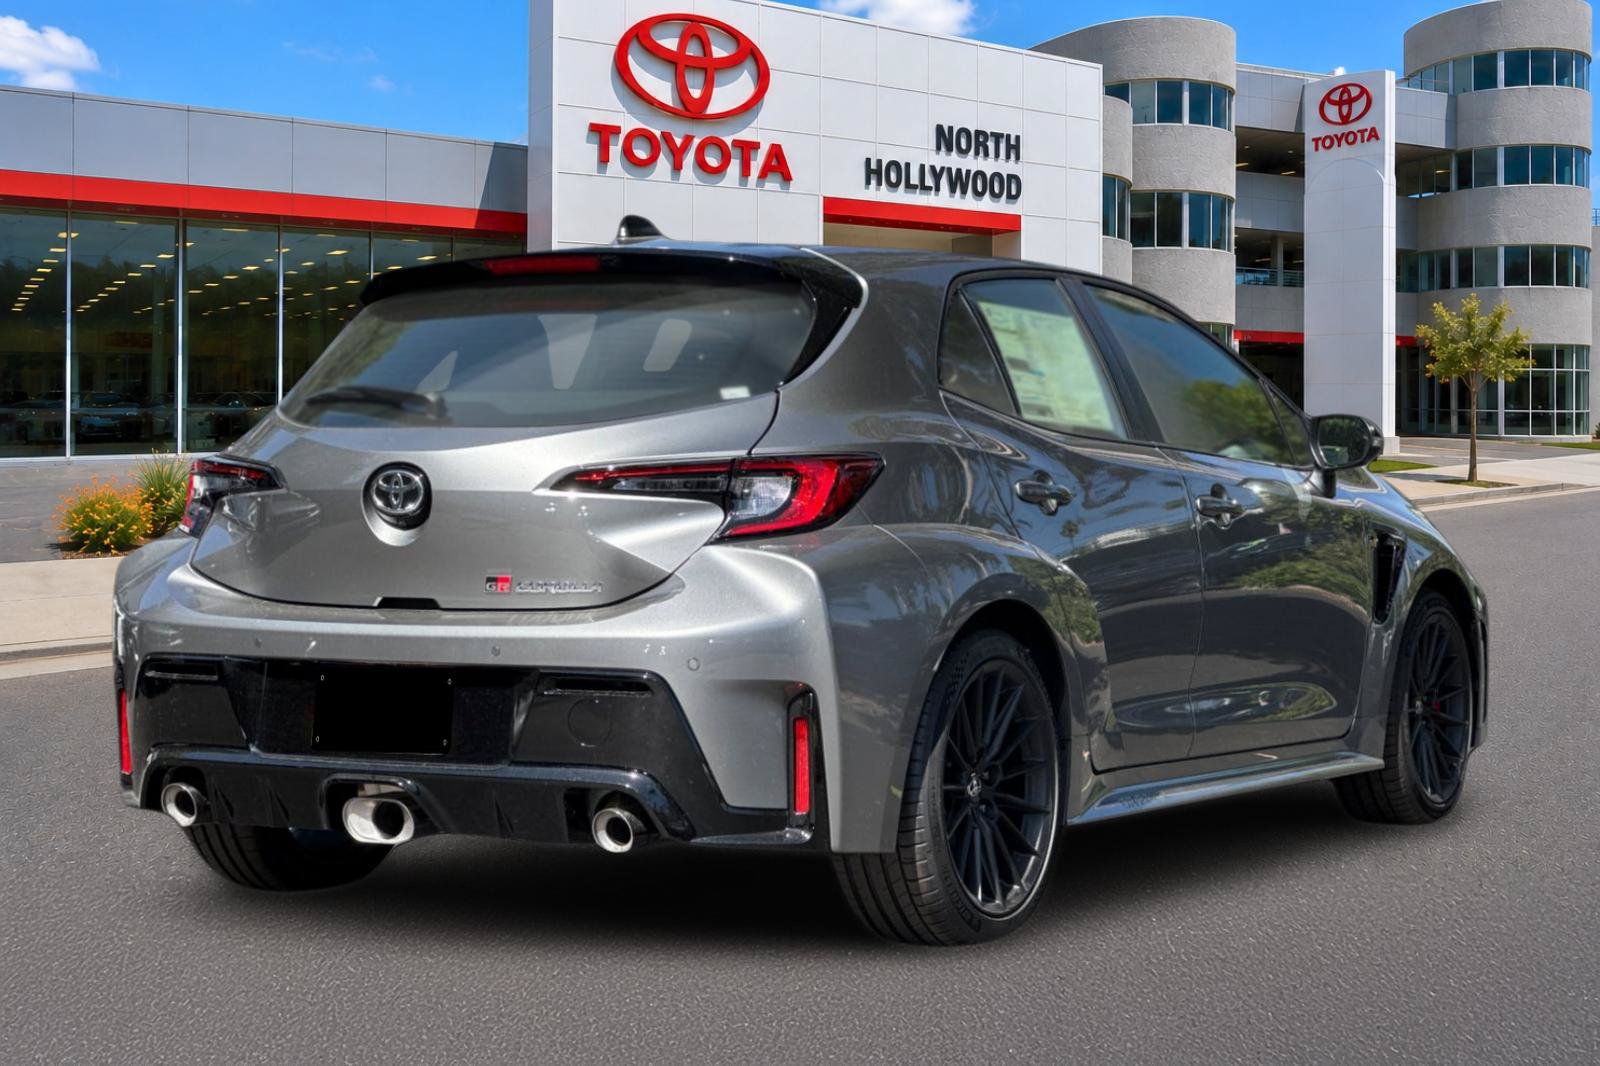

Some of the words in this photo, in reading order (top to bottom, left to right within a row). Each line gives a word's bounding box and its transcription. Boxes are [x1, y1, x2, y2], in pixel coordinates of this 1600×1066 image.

[588, 122, 793, 182] TOYOTA
[935, 124, 1021, 162] NORTH
[1311, 126, 1380, 152] TOYOTA
[865, 157, 1022, 201] HOLLYWOOD
[485, 578, 512, 592] GR
